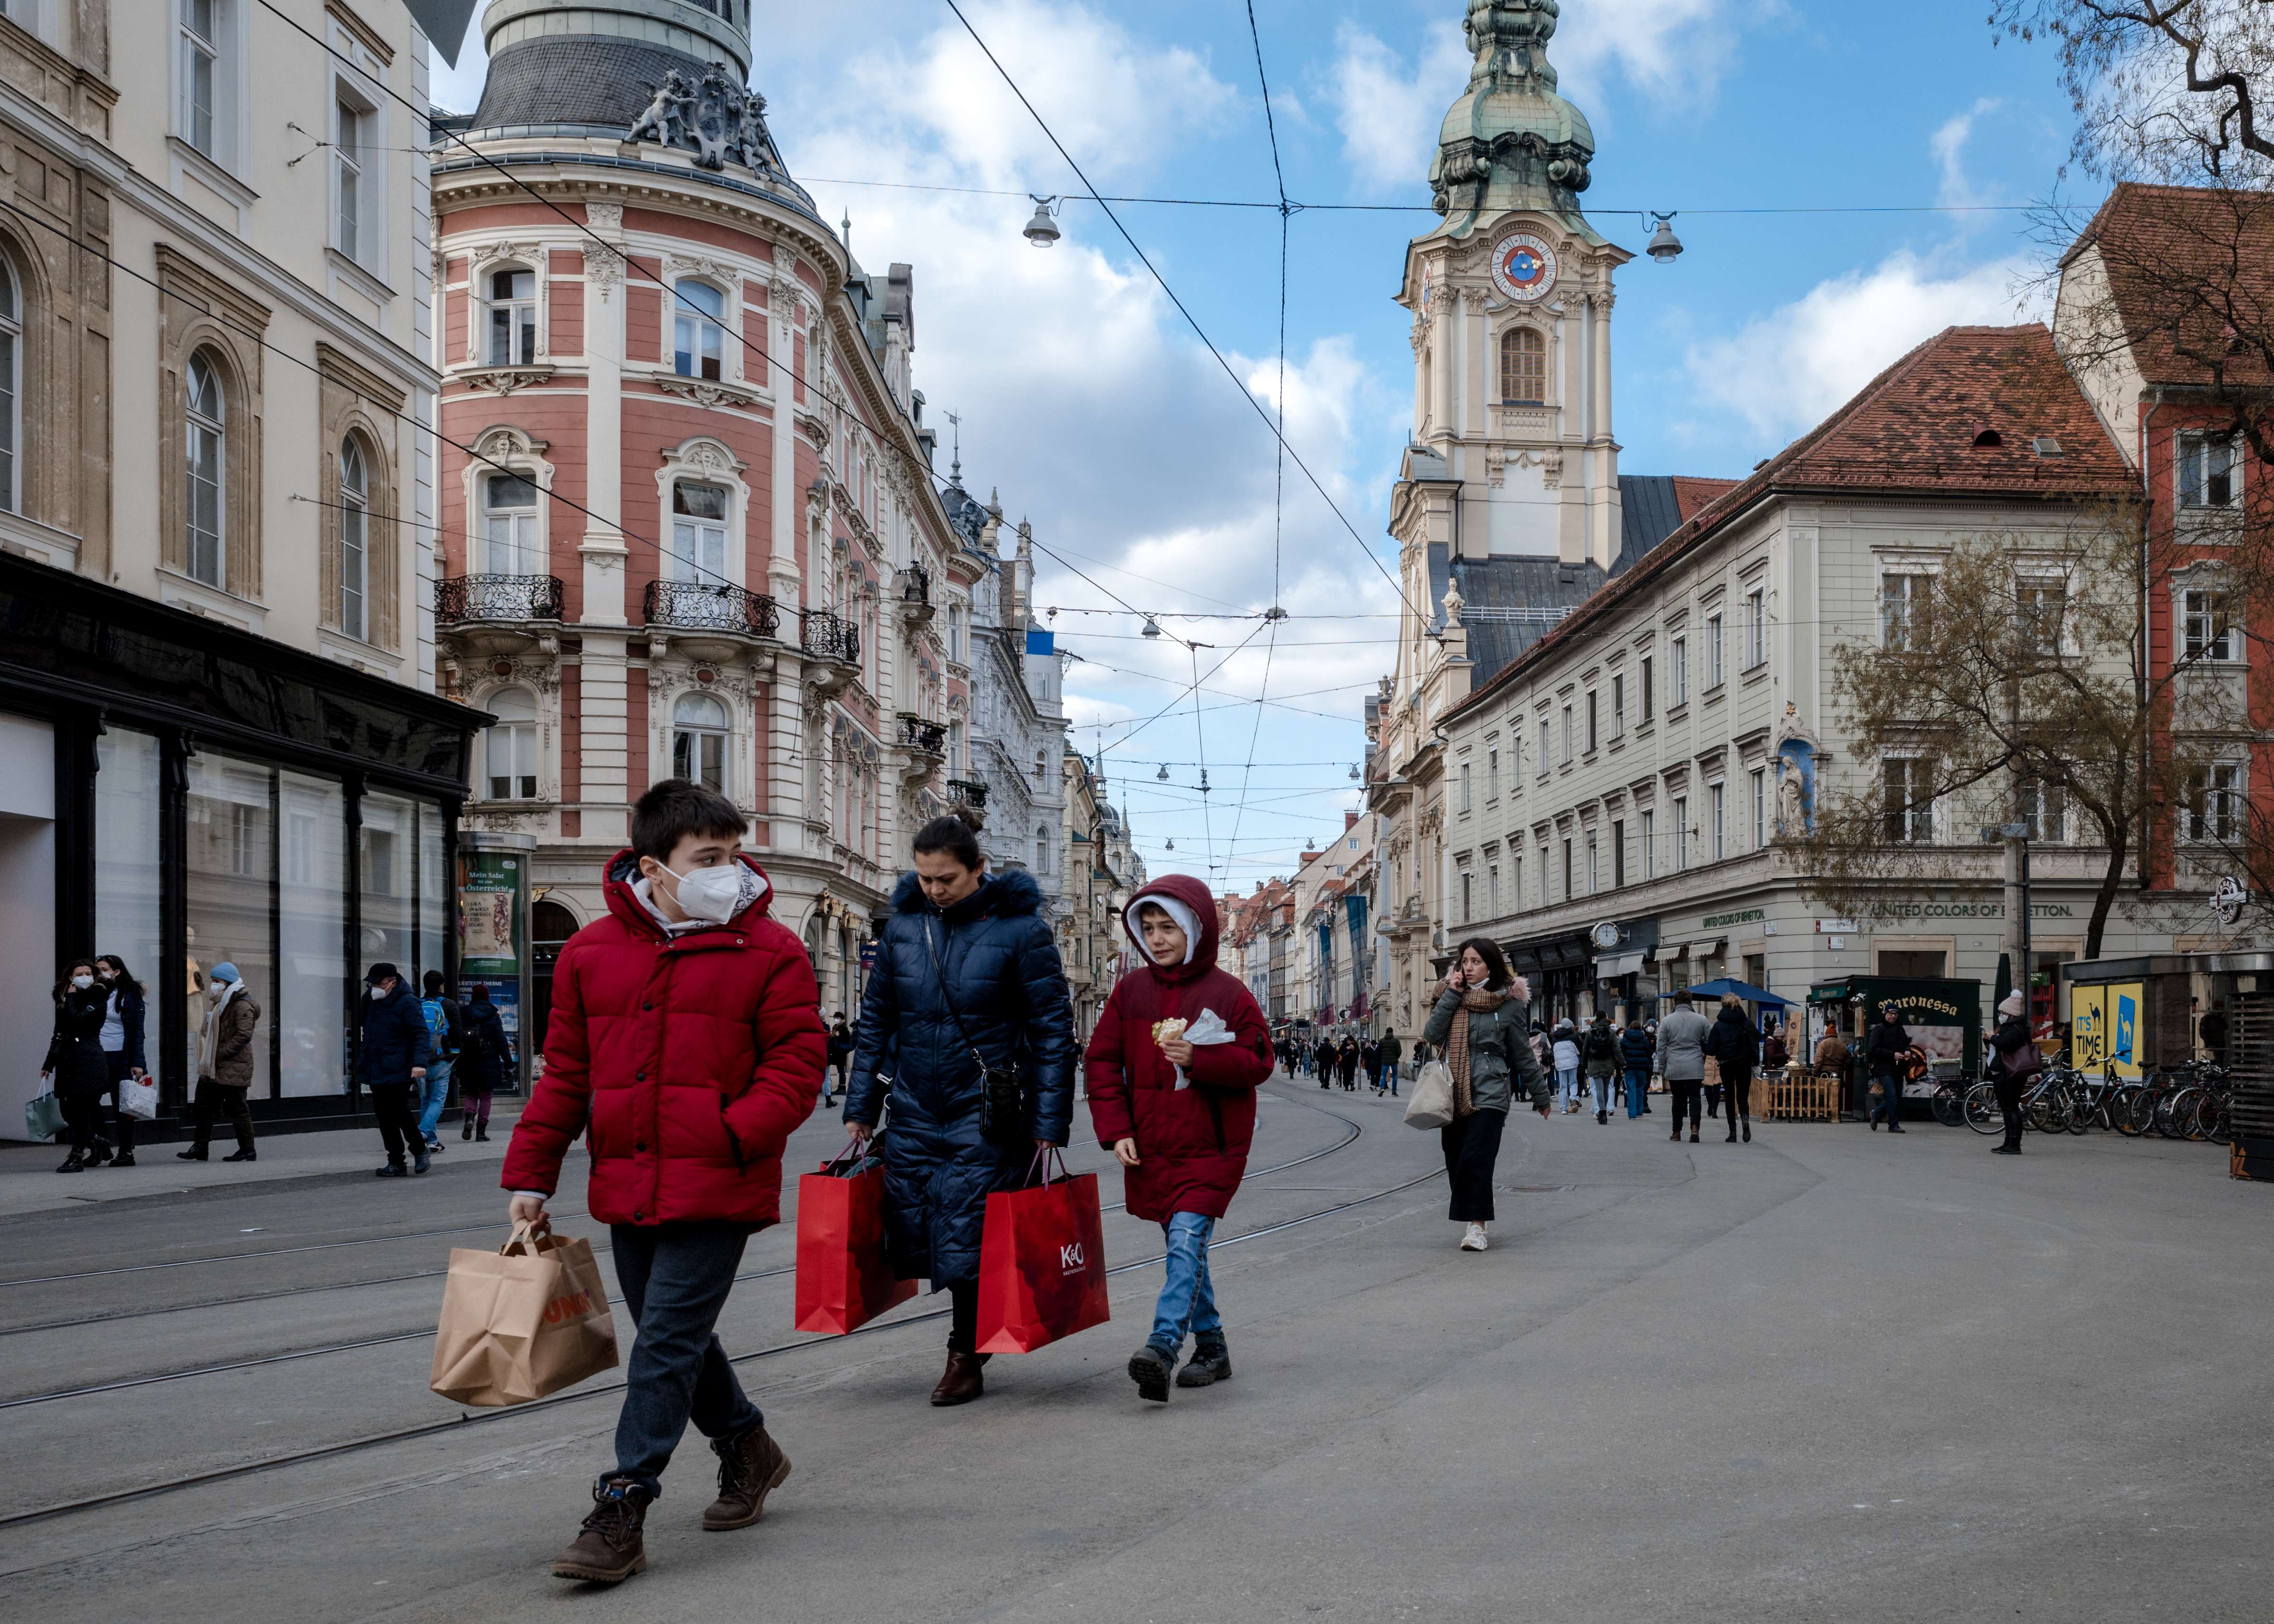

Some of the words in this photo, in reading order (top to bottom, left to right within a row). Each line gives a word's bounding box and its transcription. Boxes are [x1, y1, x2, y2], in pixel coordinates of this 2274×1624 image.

[466, 883, 508, 892] Österreich!
[1872, 904, 1921, 916] UNITED
[1925, 904, 1977, 916] COLORS
[1980, 905, 1998, 916] OF
[1703, 916, 1718, 928] UNITED
[1718, 914, 1734, 926] COLORS
[1734, 912, 1741, 923] OF
[1741, 909, 1765, 922] BENETTON.
[2076, 1016, 2091, 1031] IT'S
[2076, 1035, 2101, 1055] TIME
